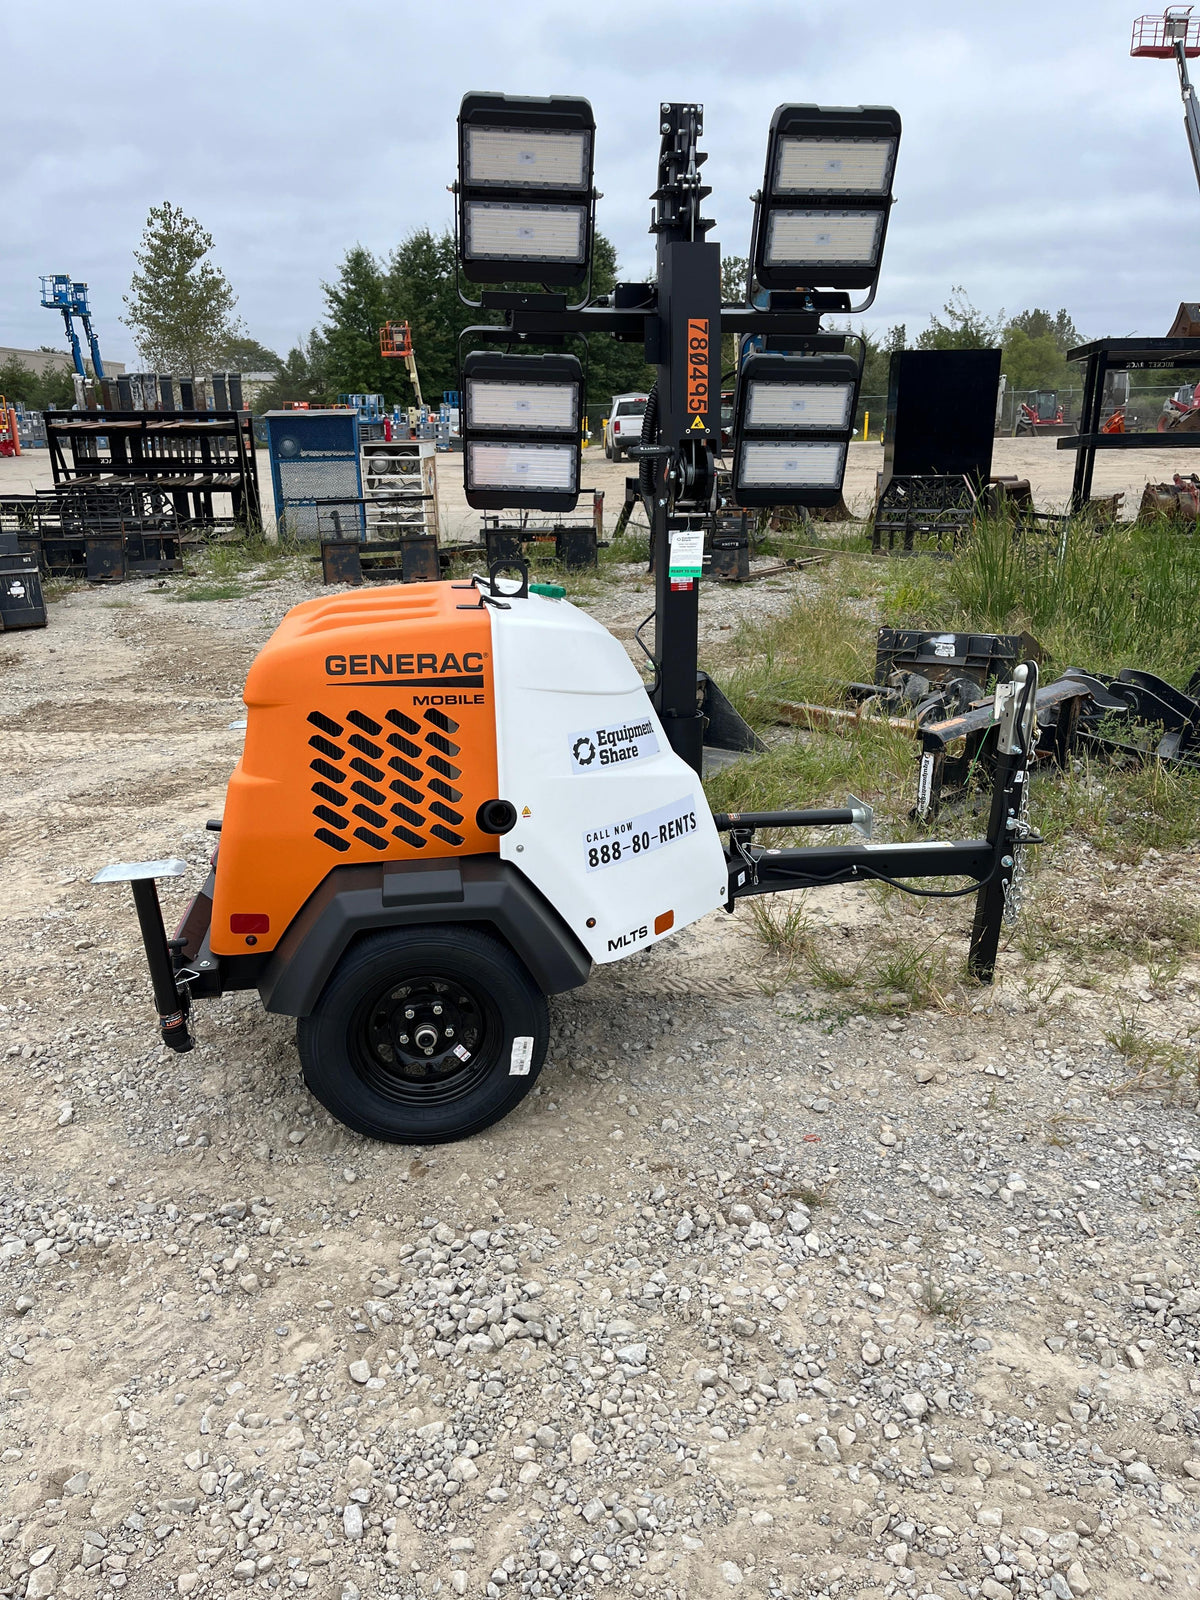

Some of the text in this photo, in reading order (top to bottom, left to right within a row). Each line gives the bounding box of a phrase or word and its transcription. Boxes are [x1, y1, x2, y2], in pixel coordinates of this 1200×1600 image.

[689, 321, 708, 411] 780495
[412, 694, 485, 706] MOBILE
[596, 720, 655, 747] Equipment
[599, 745, 639, 765] Share
[586, 821, 633, 843] CALL NOW
[588, 811, 697, 867] 888-80-RENTS
[607, 925, 648, 952] MLTS
